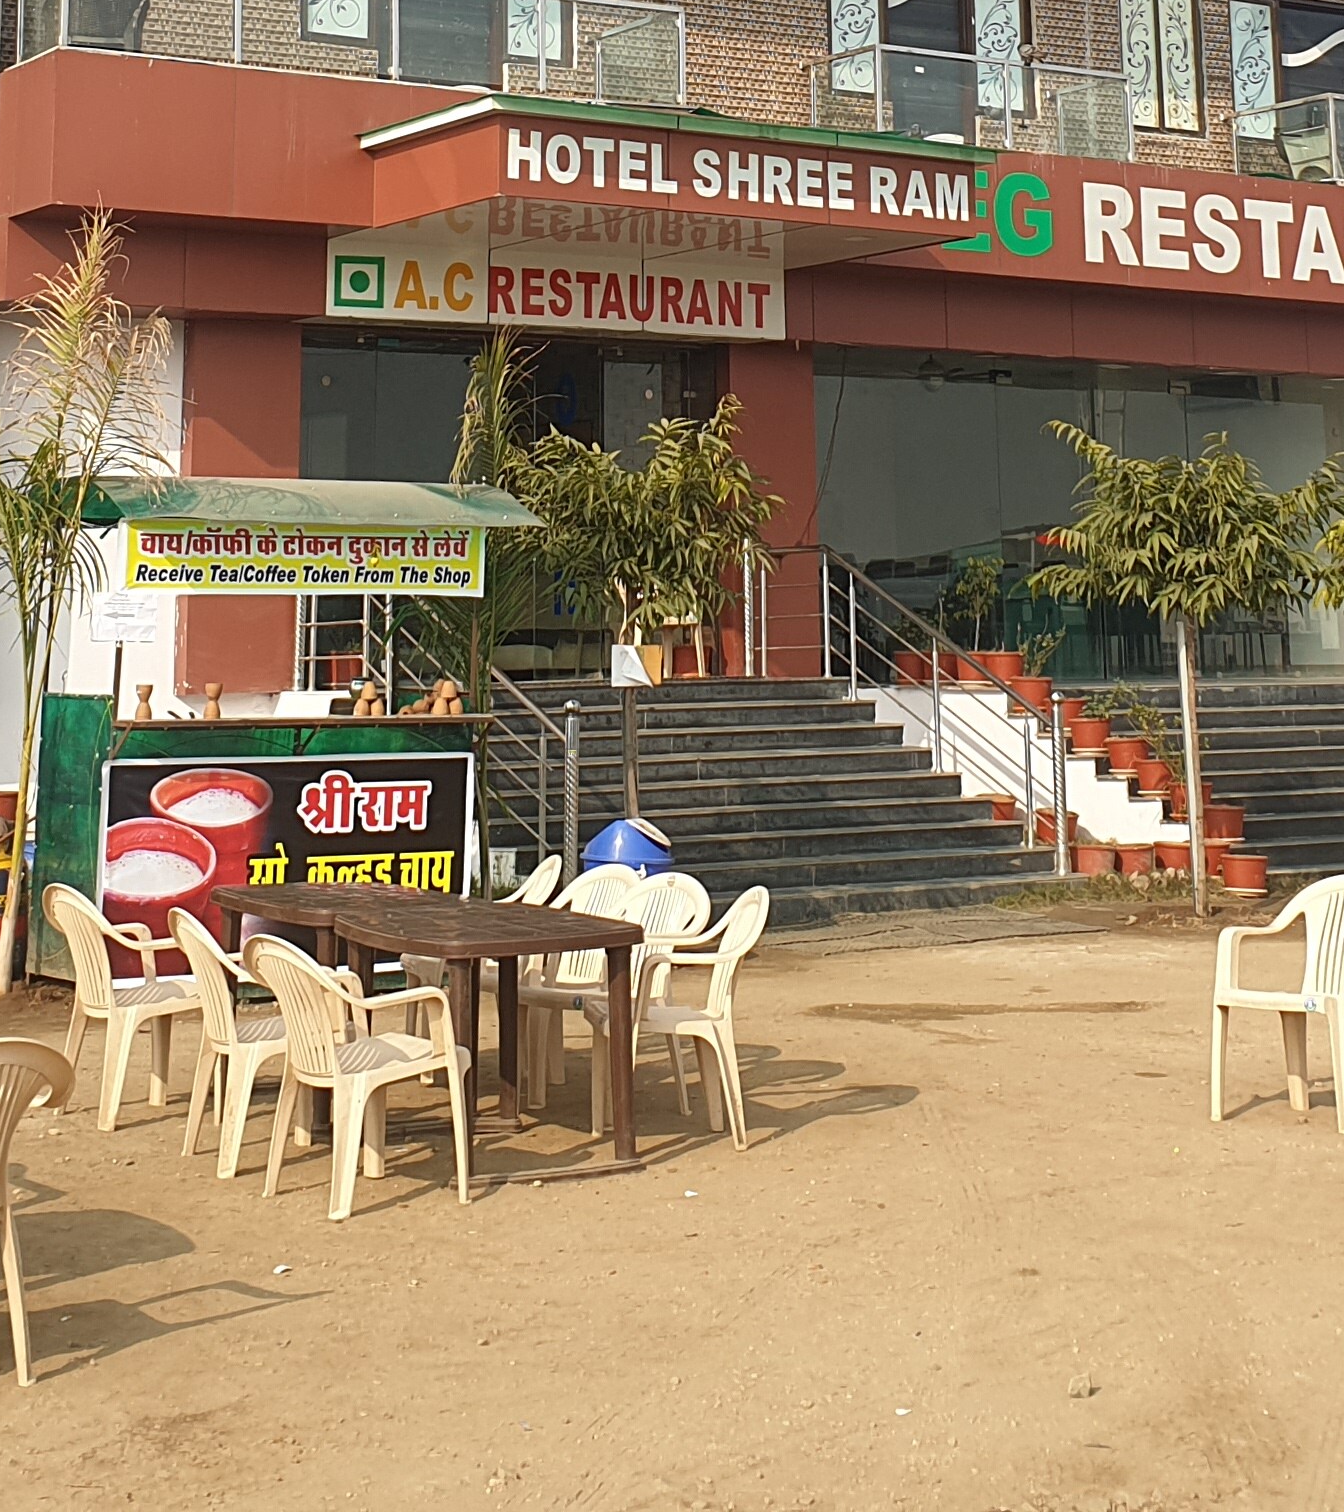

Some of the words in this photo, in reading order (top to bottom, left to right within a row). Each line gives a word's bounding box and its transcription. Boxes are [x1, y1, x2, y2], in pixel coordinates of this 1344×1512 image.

[505, 125, 680, 195] HOTEL
[690, 146, 856, 212] SHREE
[868, 165, 971, 223] RAM
[393, 260, 476, 313] A.C
[488, 266, 772, 330] RESTAURANT
[136, 564, 204, 584] Receive
[209, 565, 297, 584] Tea/Coffee
[302, 565, 350, 585] Token
[354, 566, 395, 585] From
[399, 565, 429, 585] The
[433, 565, 472, 587] Shop
[139, 527, 253, 557] चाय/कॉफी
[256, 528, 278, 556] के
[282, 529, 344, 557] टोकन
[347, 532, 408, 565] दुकान
[411, 529, 430, 558] से
[299, 772, 356, 832] श्री
[358, 781, 432, 832] राम
